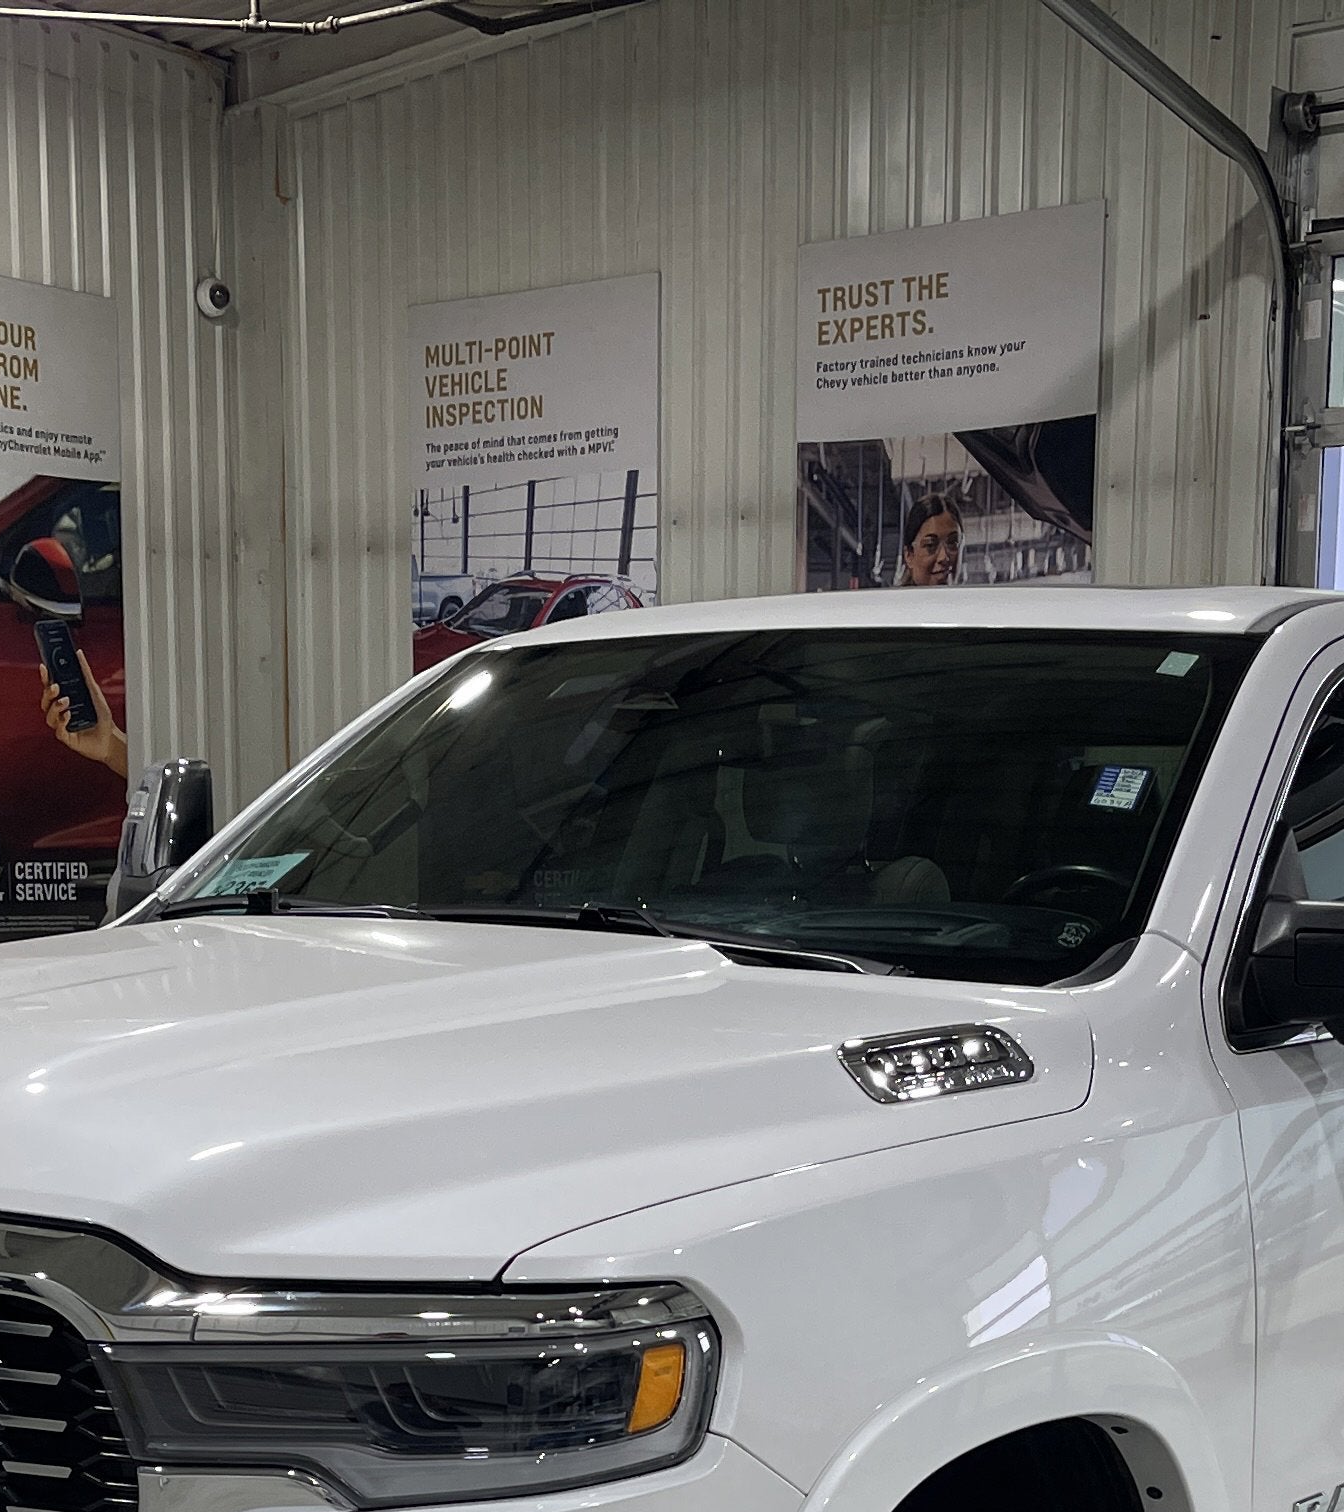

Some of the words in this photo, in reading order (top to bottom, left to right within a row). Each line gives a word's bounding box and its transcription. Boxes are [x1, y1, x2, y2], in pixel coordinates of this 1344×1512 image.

[817, 279, 895, 313] TRUST
[902, 272, 950, 304] THE
[817, 309, 934, 346] EXPERTS.
[425, 332, 555, 368] MULTI-POINT
[816, 360, 857, 375] Factory
[859, 354, 898, 370] trained
[901, 348, 964, 366] technicians
[967, 344, 998, 358] know
[1000, 340, 1027, 356] your
[424, 368, 508, 398] VEHICLE
[816, 376, 849, 391] Chevy
[850, 371, 888, 387] vehicle
[891, 367, 926, 384] better
[928, 364, 954, 379] than
[956, 361, 1000, 378] anyone.
[425, 395, 543, 429] INSPECTION
[16, 426, 33, 438] and
[35, 429, 59, 443] enjoy
[60, 433, 92, 446] remote
[425, 442, 441, 454] The
[443, 440, 468, 456] peace
[471, 437, 481, 450] of
[482, 435, 505, 449] mind
[507, 434, 526, 447] that
[528, 432, 558, 444] comes
[559, 429, 582, 443] from
[585, 426, 619, 442] getting
[53, 445, 82, 460] Mobile
[425, 458, 446, 471] your
[447, 452, 485, 468] vehicle's
[486, 449, 515, 464] health
[517, 446, 555, 461] checked
[557, 444, 577, 458] with
[579, 446, 586, 455] a
[14, 861, 89, 880] CERTIFIED
[15, 883, 77, 901] SERVICE
